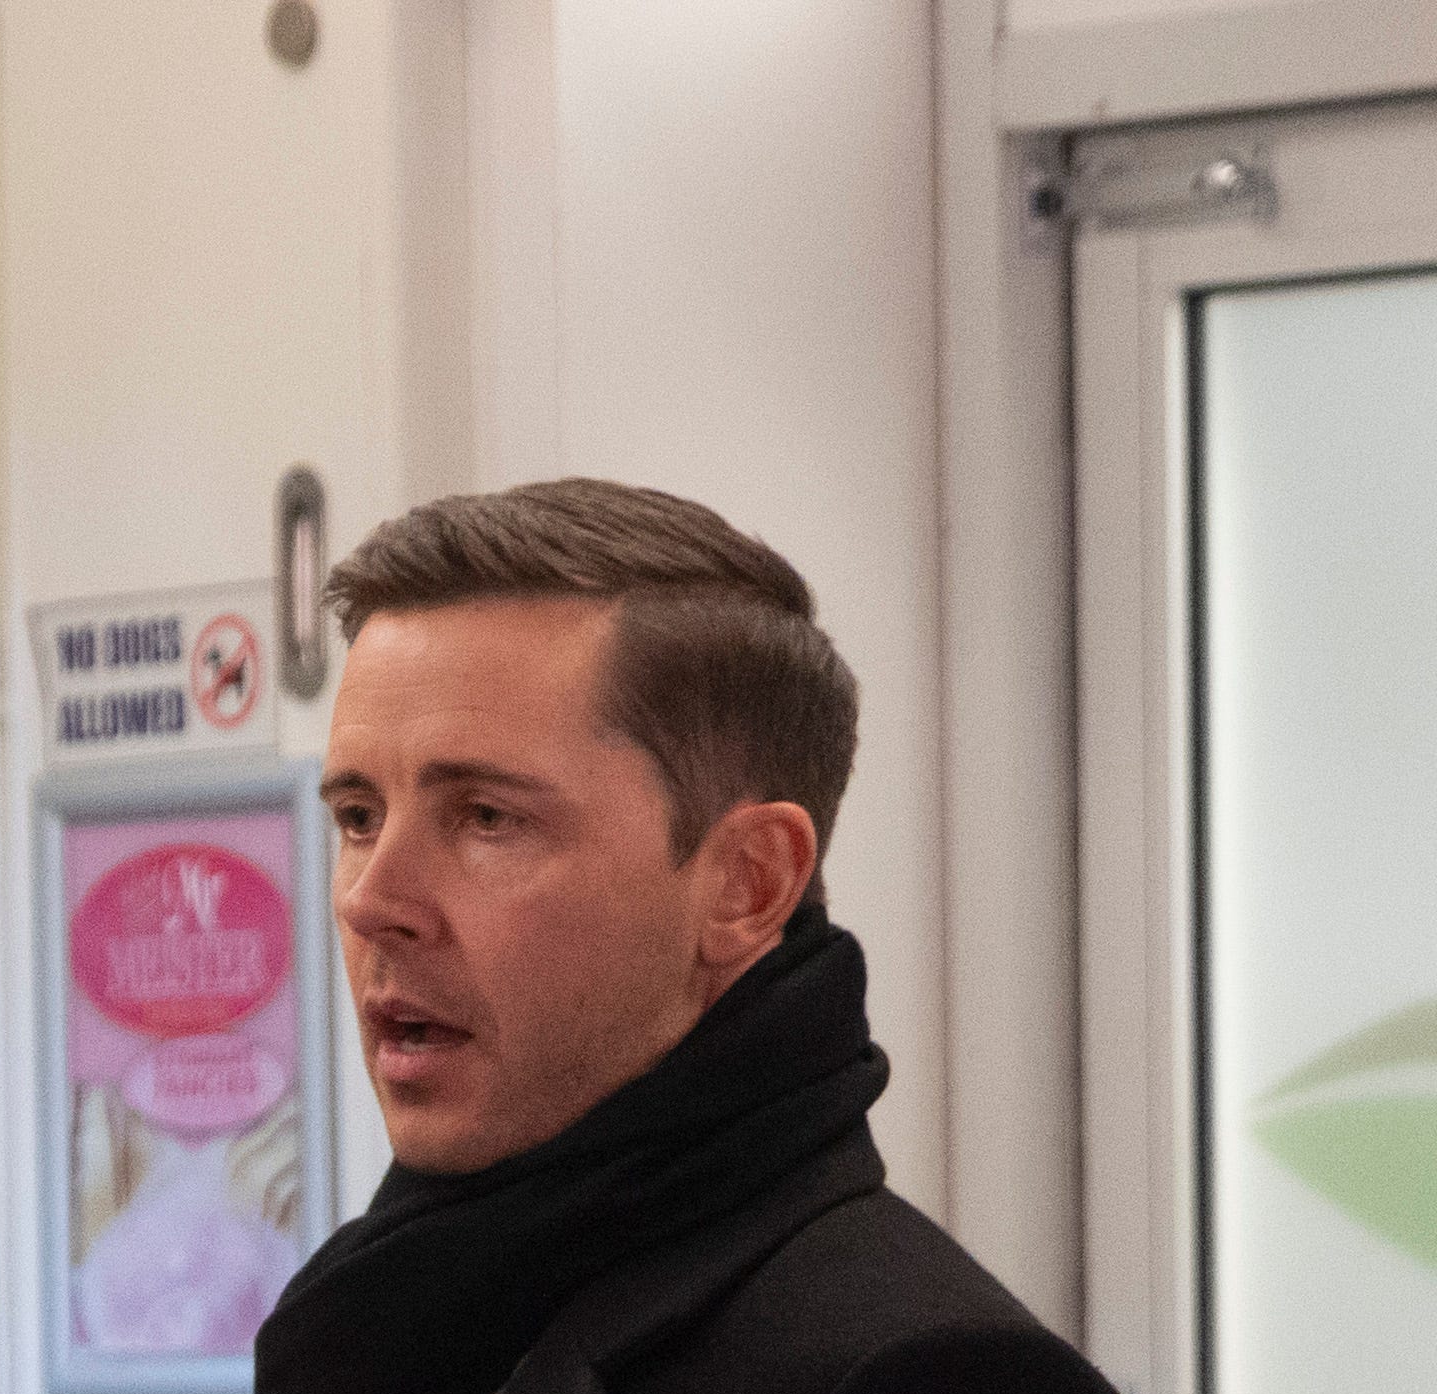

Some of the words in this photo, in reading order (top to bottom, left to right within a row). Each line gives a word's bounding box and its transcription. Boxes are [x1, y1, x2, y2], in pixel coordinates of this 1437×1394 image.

[57, 626, 96, 674] NO
[103, 616, 182, 669] DOGS
[56, 688, 186, 744] ALLOWED
